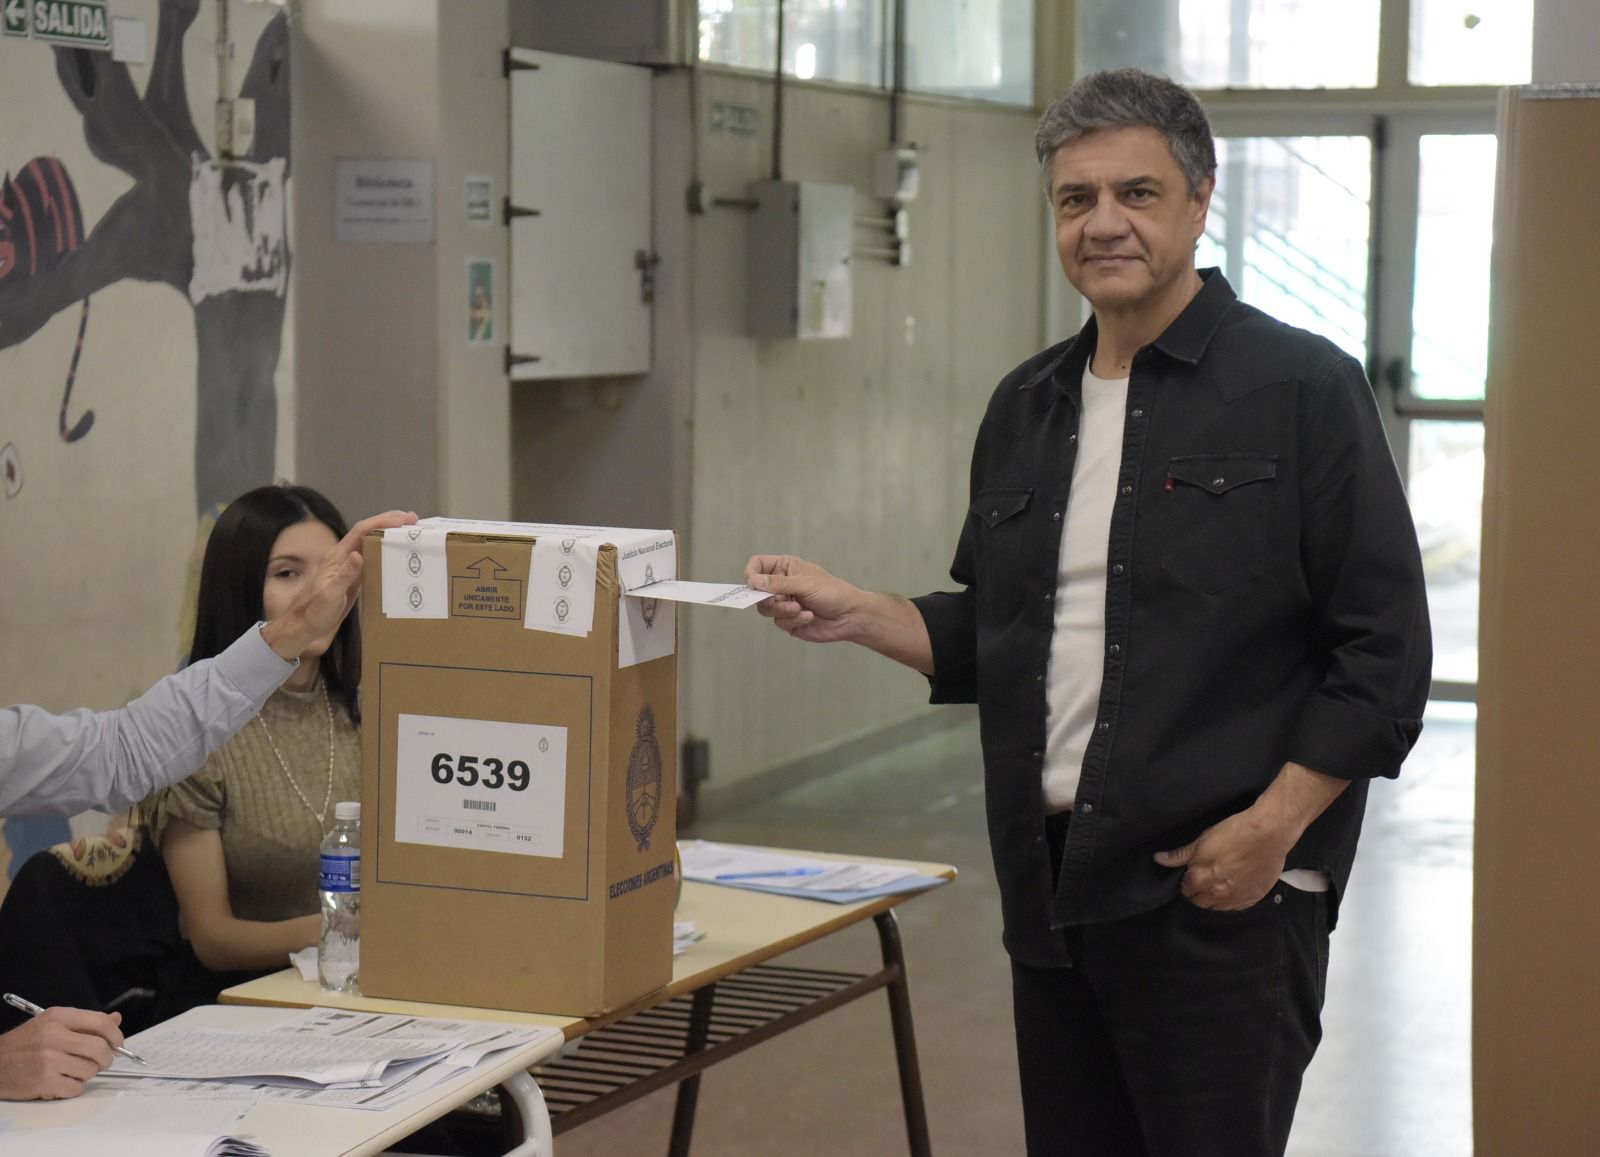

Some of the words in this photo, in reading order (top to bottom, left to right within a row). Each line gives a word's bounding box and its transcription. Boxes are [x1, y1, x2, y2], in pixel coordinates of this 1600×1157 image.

[35, 0, 106, 37] SALIDA
[475, 585, 498, 593] ABRIR
[458, 602, 474, 610] POR
[475, 603, 494, 612] ESTE
[494, 605, 515, 613] LADO
[431, 753, 530, 792] 6539
[516, 834, 532, 842] 0152
[609, 874, 643, 900] ELECCIONES
[643, 860, 674, 888] ARGENTINAS
